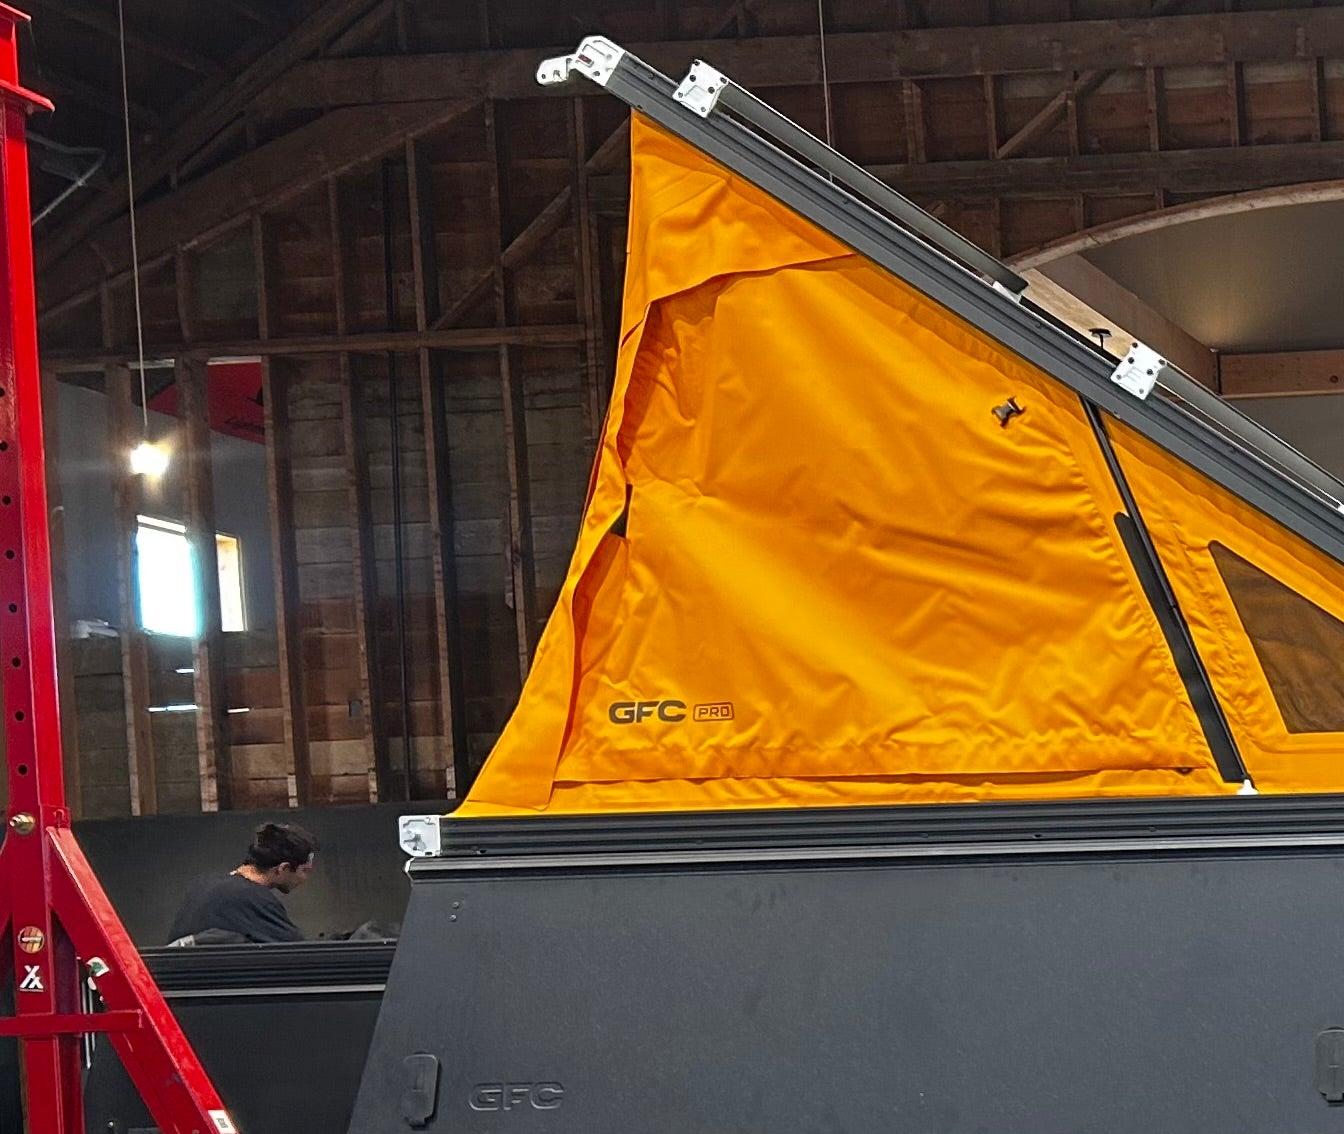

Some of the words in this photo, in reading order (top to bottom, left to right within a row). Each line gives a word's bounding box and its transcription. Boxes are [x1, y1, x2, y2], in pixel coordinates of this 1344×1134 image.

[608, 699, 687, 725] GFC
[698, 705, 730, 719] PRO
[469, 1081, 564, 1111] GFC
